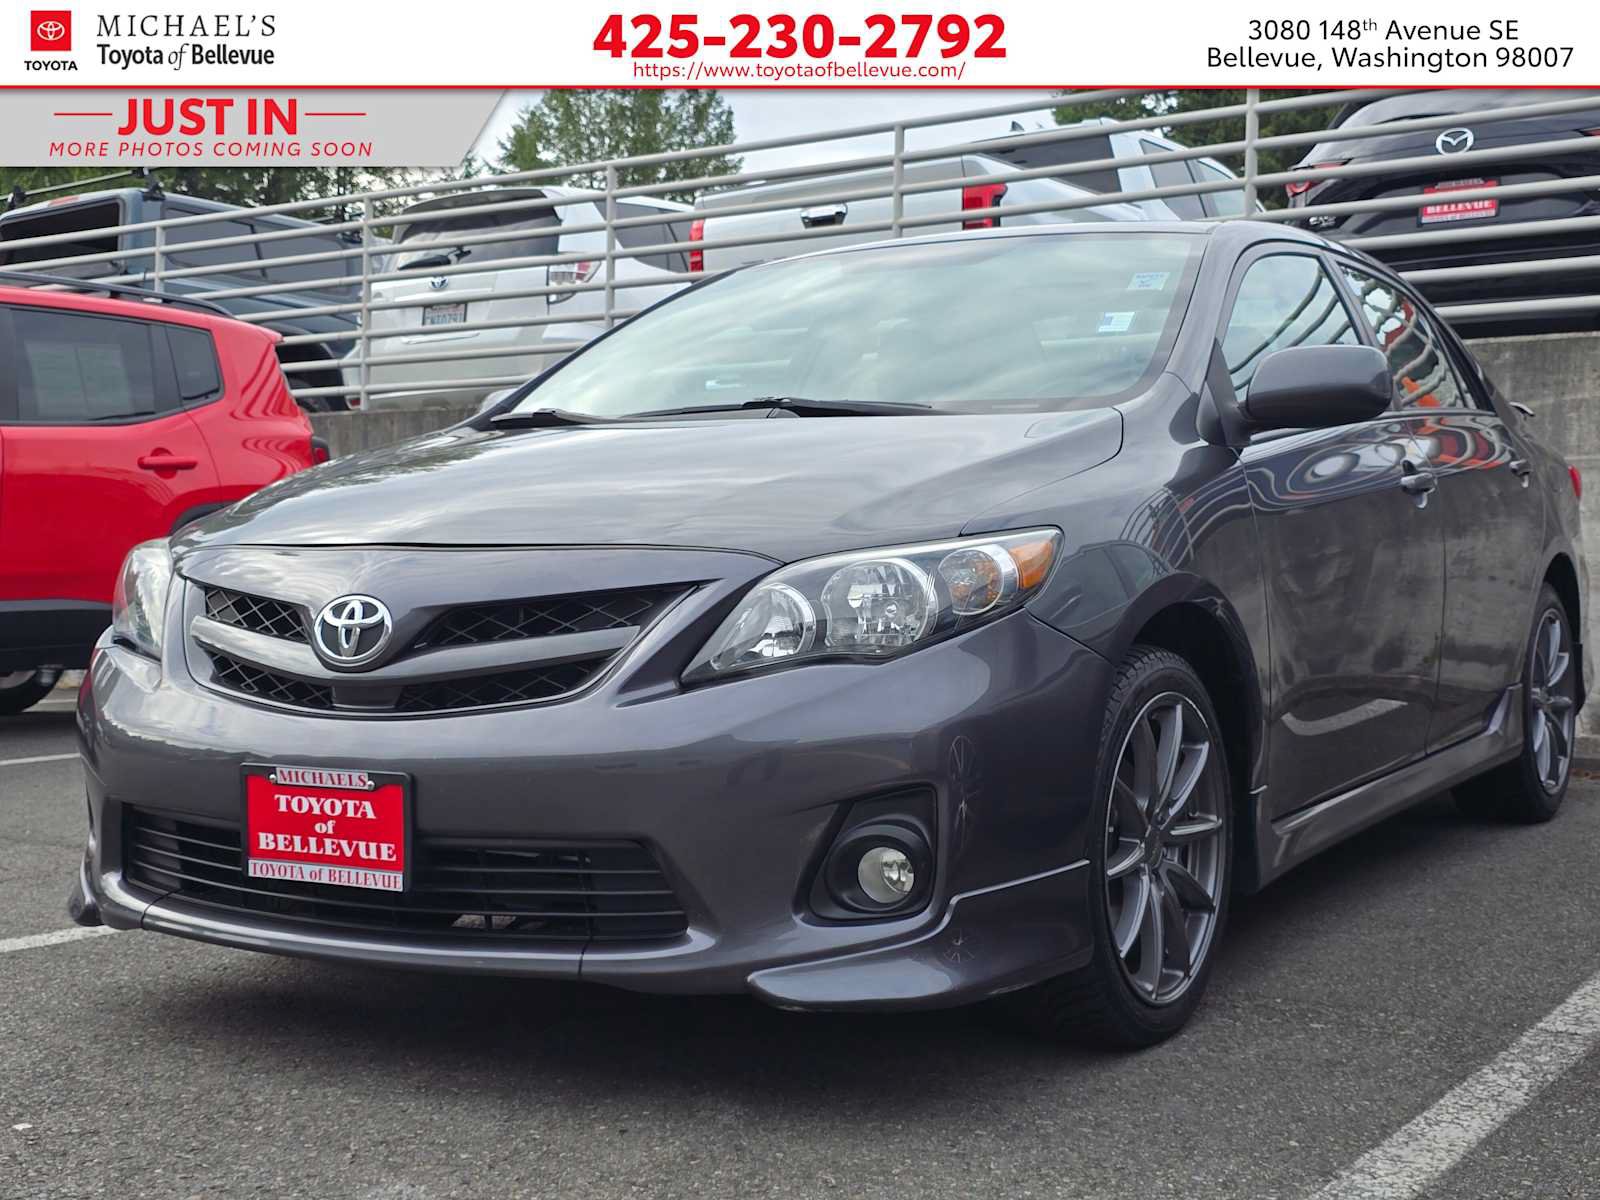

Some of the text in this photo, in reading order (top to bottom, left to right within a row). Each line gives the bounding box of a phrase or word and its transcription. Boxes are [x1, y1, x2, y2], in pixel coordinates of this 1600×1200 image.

[274, 794, 377, 819] TOYOTA
[314, 820, 336, 834] of
[258, 832, 397, 862] BELLEVUE
[251, 861, 401, 890] TOYOTA of BELLEVUE
